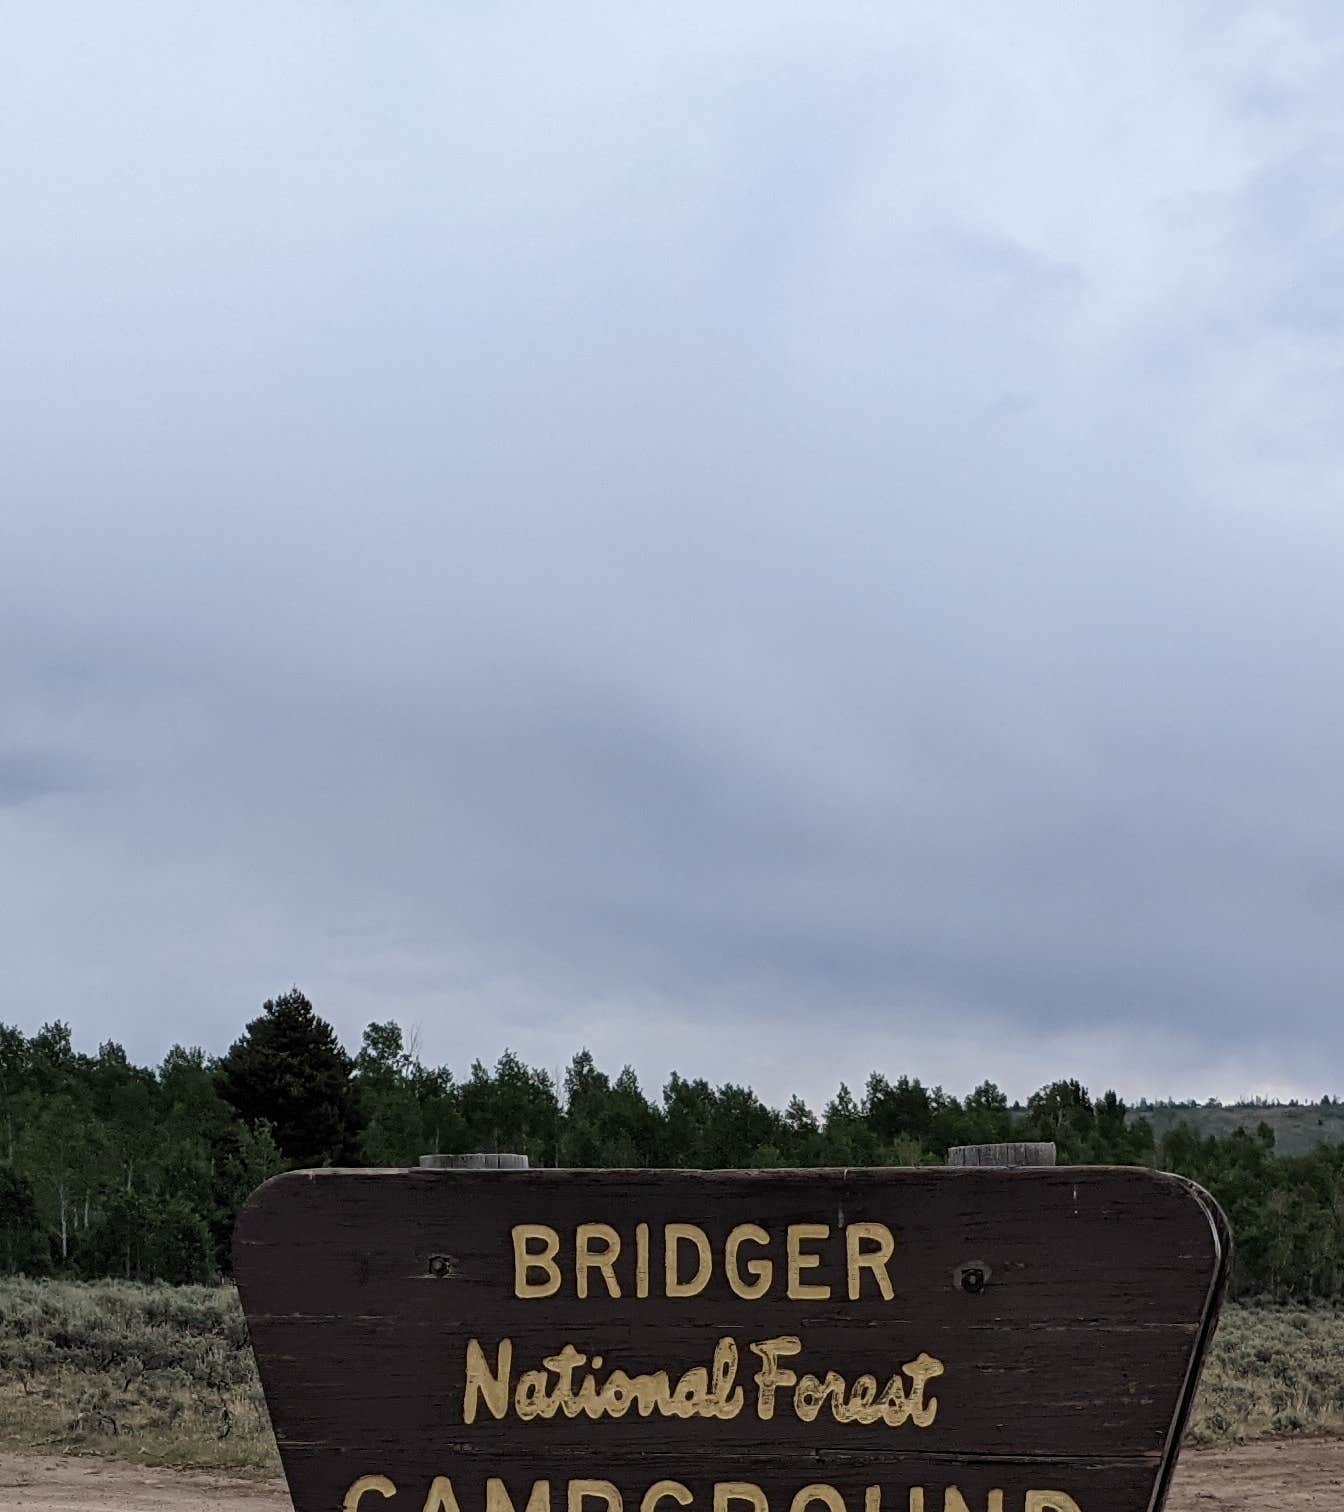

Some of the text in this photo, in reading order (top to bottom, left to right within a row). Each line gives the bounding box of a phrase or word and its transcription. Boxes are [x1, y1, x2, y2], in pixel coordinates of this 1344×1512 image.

[511, 1222, 895, 1301] BRIDGER
[463, 1335, 945, 1428] National Forest
